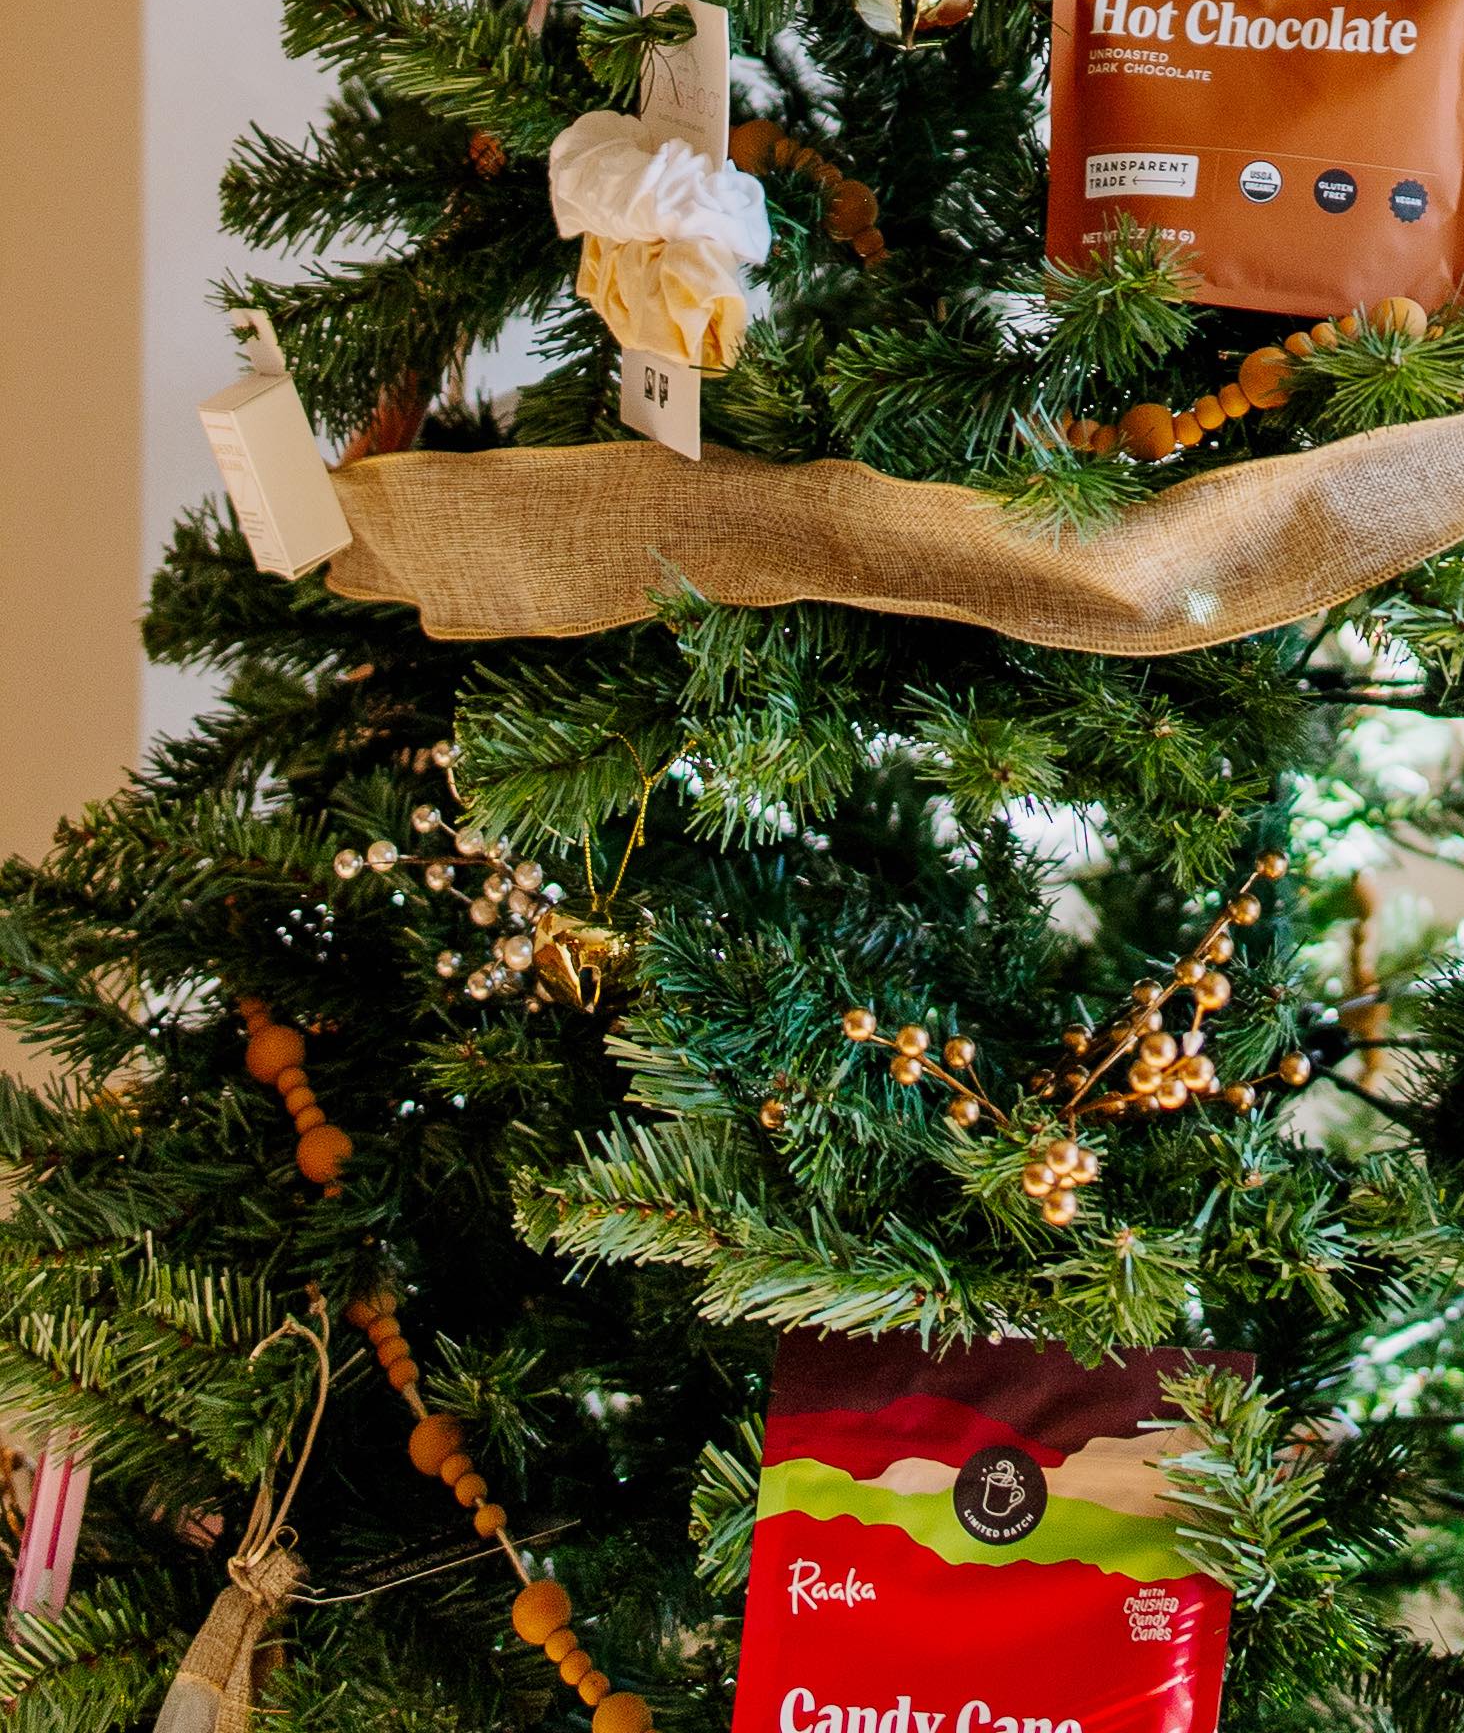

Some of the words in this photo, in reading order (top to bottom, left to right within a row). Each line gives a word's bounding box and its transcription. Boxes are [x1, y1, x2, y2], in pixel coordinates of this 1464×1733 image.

[1089, 48, 1169, 63] UNROASTED
[1087, 62, 1118, 74] DARK
[1123, 63, 1213, 81] CHOCOLATE
[1089, 161, 1190, 174] TRANSPARENT
[1089, 175, 1127, 189] TRADE
[1250, 170, 1273, 181] USDA
[1318, 180, 1354, 193] GLUTEN
[1322, 190, 1347, 201] FREE
[1394, 195, 1423, 207] VEGAN
[963, 1508, 1001, 1539] LIMITED
[1003, 1512, 1035, 1539] BATCH
[787, 1557, 877, 1615] Raaka
[1139, 1587, 1166, 1598] WITH
[1123, 1596, 1179, 1614] CRUSHED
[1128, 1611, 1171, 1628] Candy
[1131, 1625, 1173, 1642] Canes
[779, 1687, 946, 1733] Candy
[955, 1699, 1083, 1733] Cane
